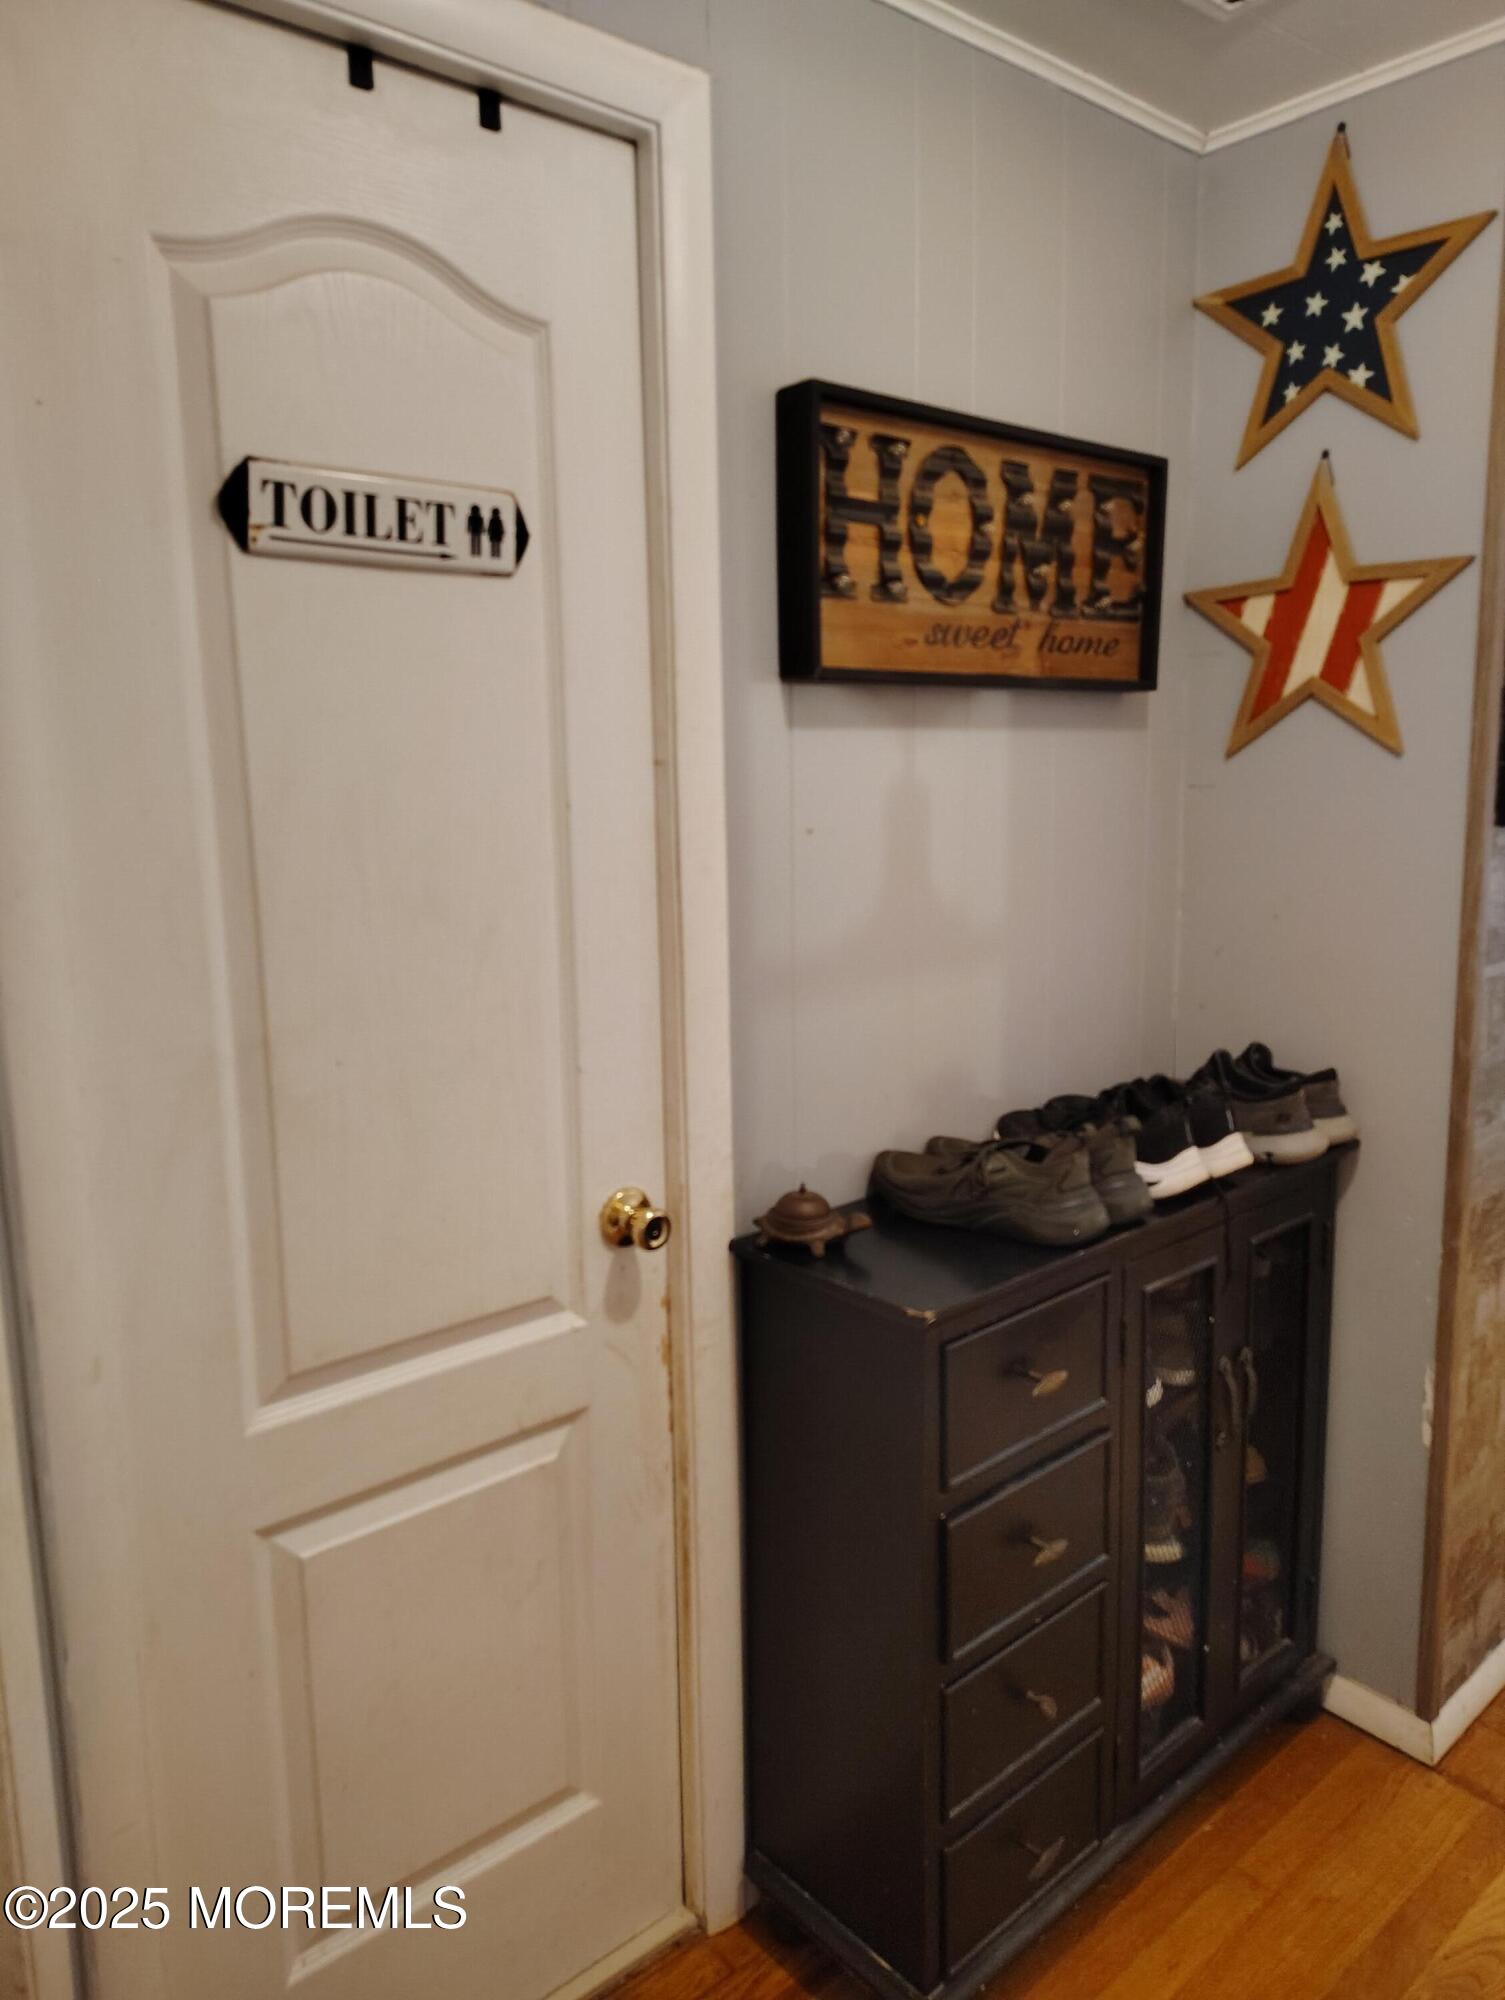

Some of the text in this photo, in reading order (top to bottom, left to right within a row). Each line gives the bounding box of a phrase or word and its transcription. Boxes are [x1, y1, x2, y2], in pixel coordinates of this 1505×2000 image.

[260, 478, 456, 546] TOILET
[820, 421, 1143, 622] HOME
[924, 619, 1121, 658] sweet home
